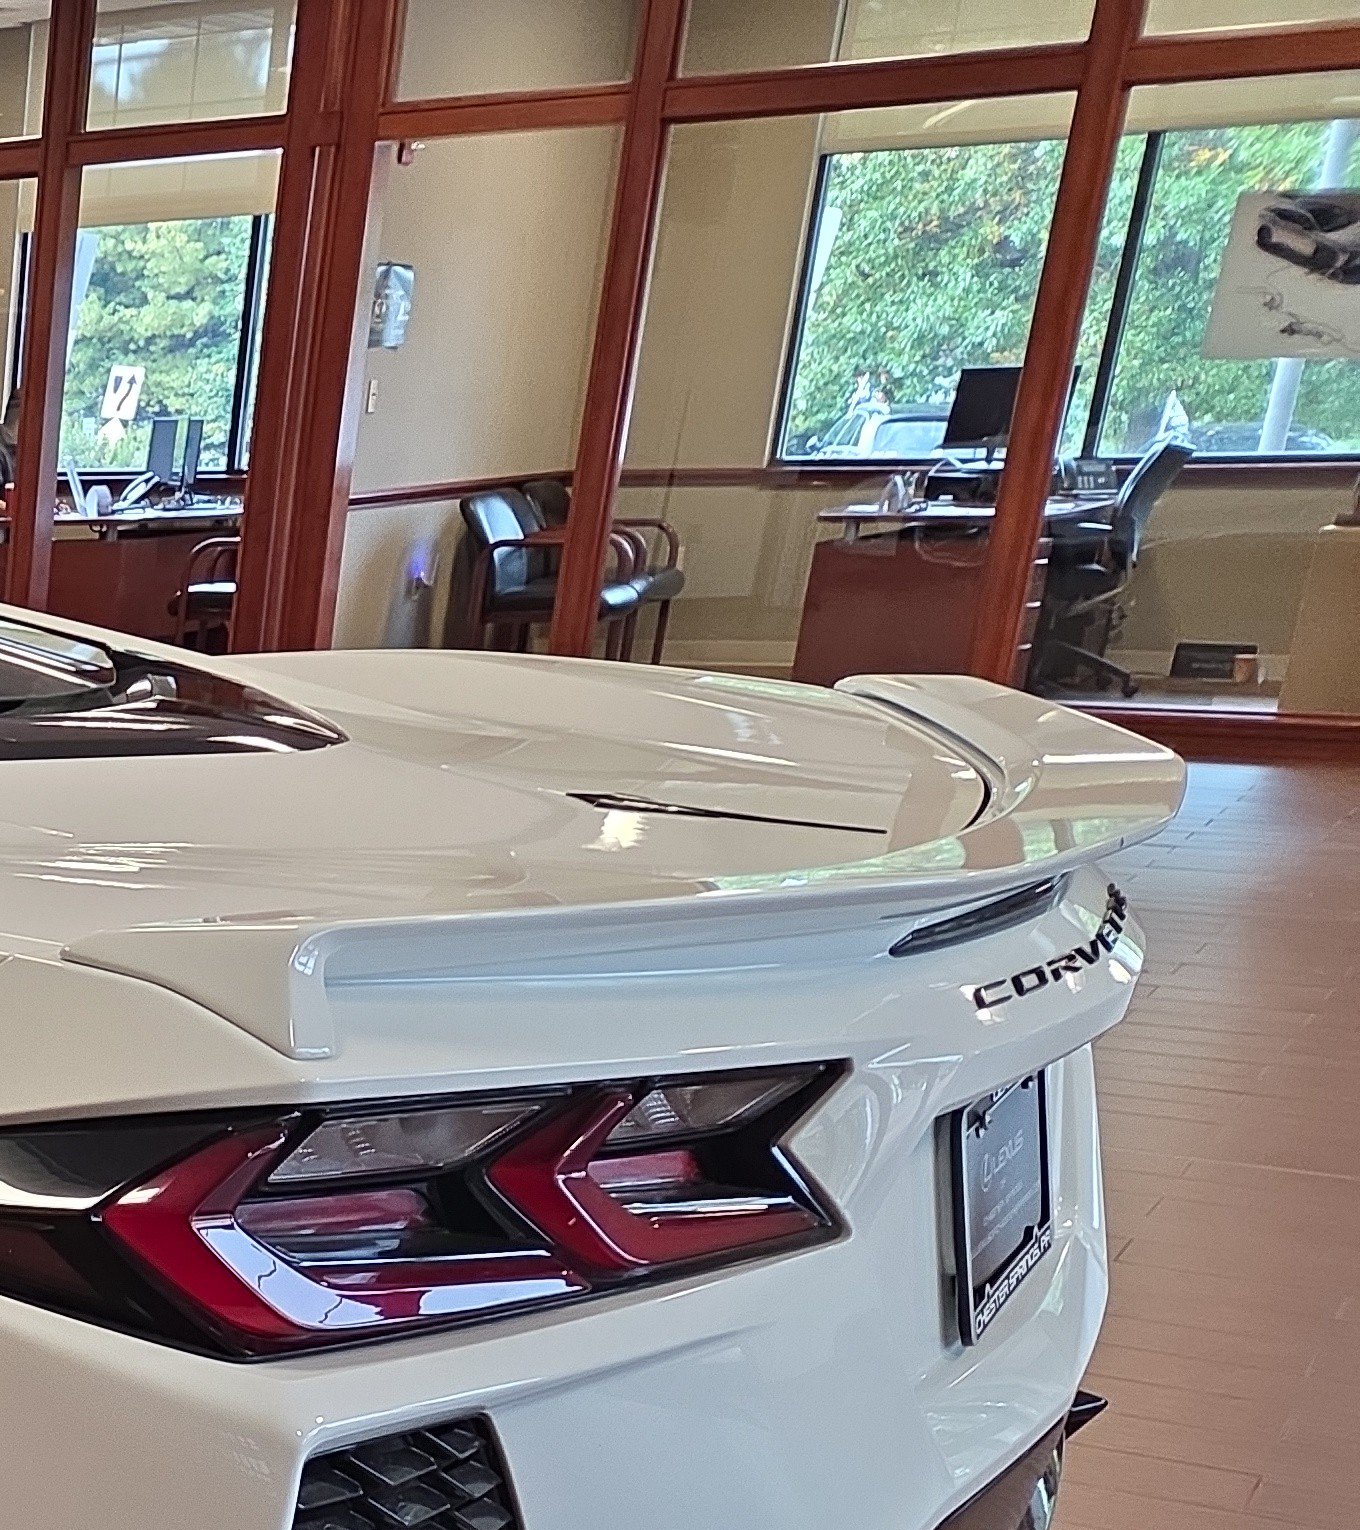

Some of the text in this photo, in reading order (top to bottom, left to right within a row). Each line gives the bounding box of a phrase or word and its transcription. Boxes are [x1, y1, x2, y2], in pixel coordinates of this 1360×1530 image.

[993, 1129, 1023, 1175] LEXUS
[976, 1280, 1010, 1335] CHESTER
[1010, 1244, 1040, 1293] SPRINGS
